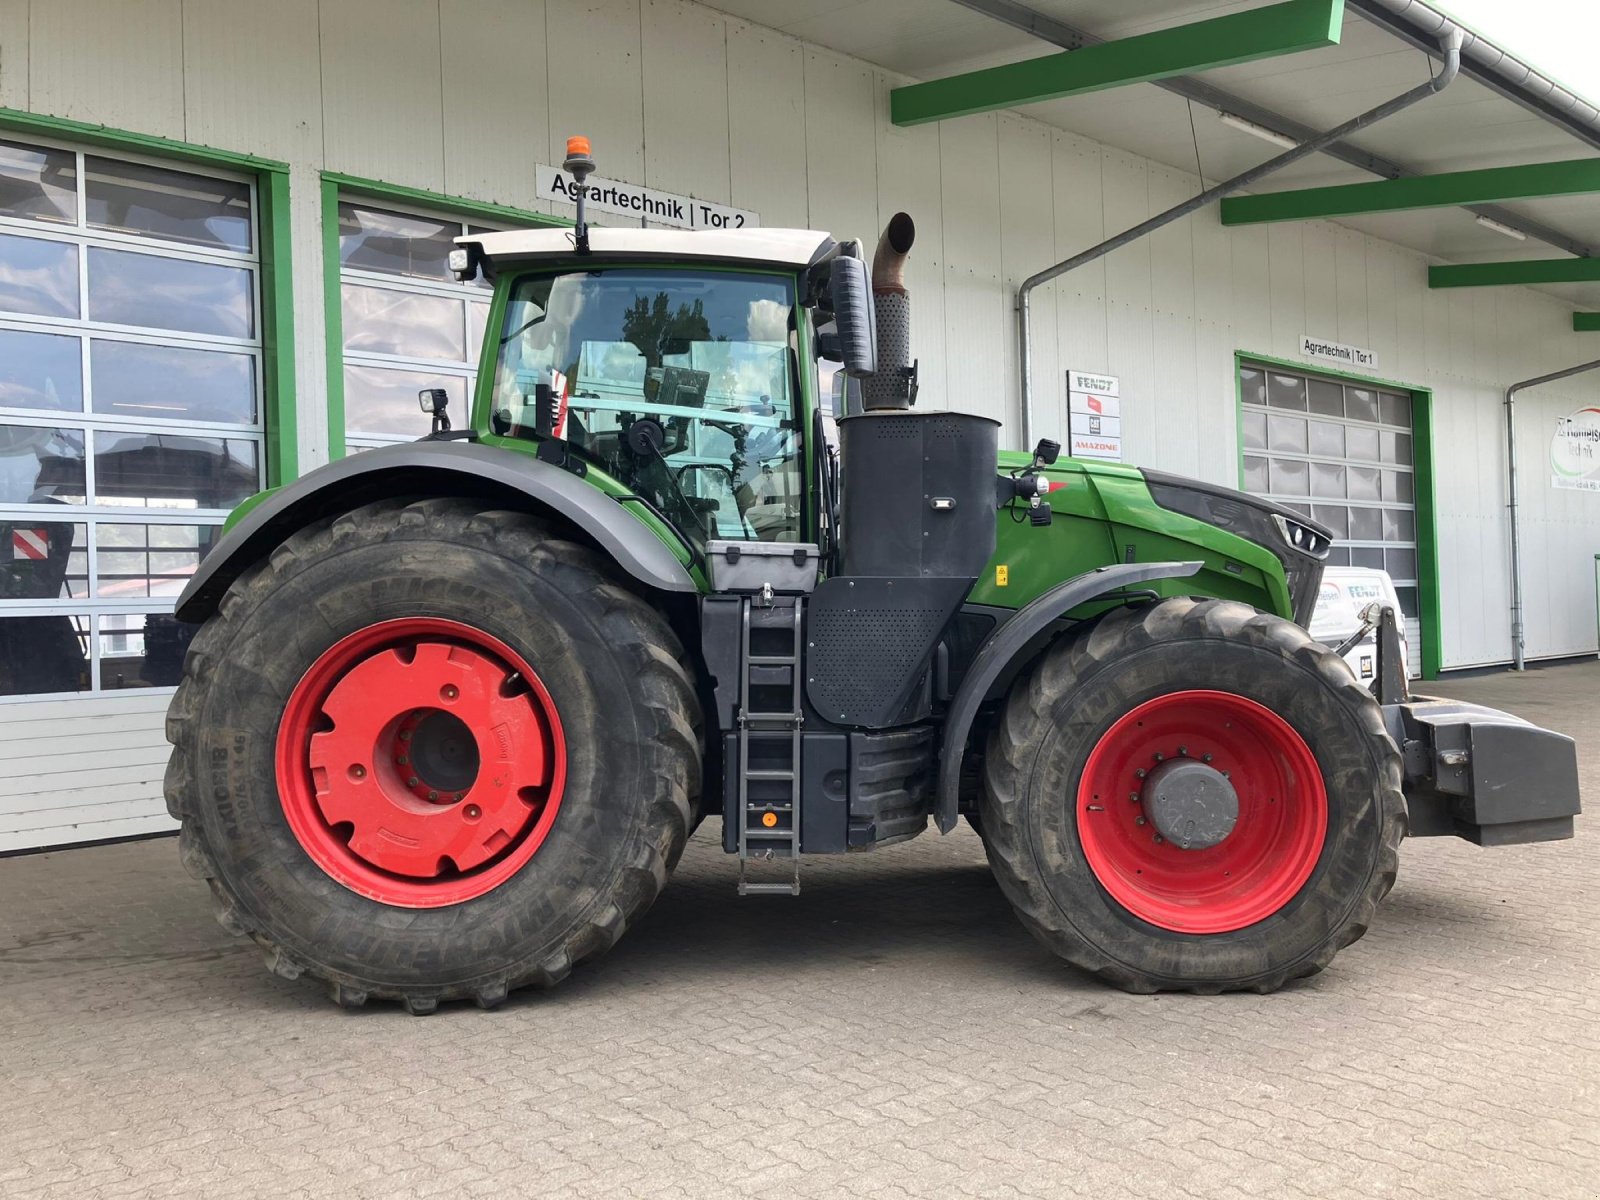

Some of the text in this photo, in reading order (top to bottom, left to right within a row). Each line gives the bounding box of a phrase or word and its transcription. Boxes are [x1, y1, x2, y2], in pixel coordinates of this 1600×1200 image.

[700, 205, 730, 228] Tor
[735, 213, 745, 228] 2
[1304, 339, 1351, 360] Agrartechnik
[1356, 350, 1367, 363] Tor
[1077, 376, 1113, 391] FENDT
[1075, 439, 1118, 451] AMAZONE
[1348, 585, 1381, 598] FENDT
[233, 735, 246, 754] 46
